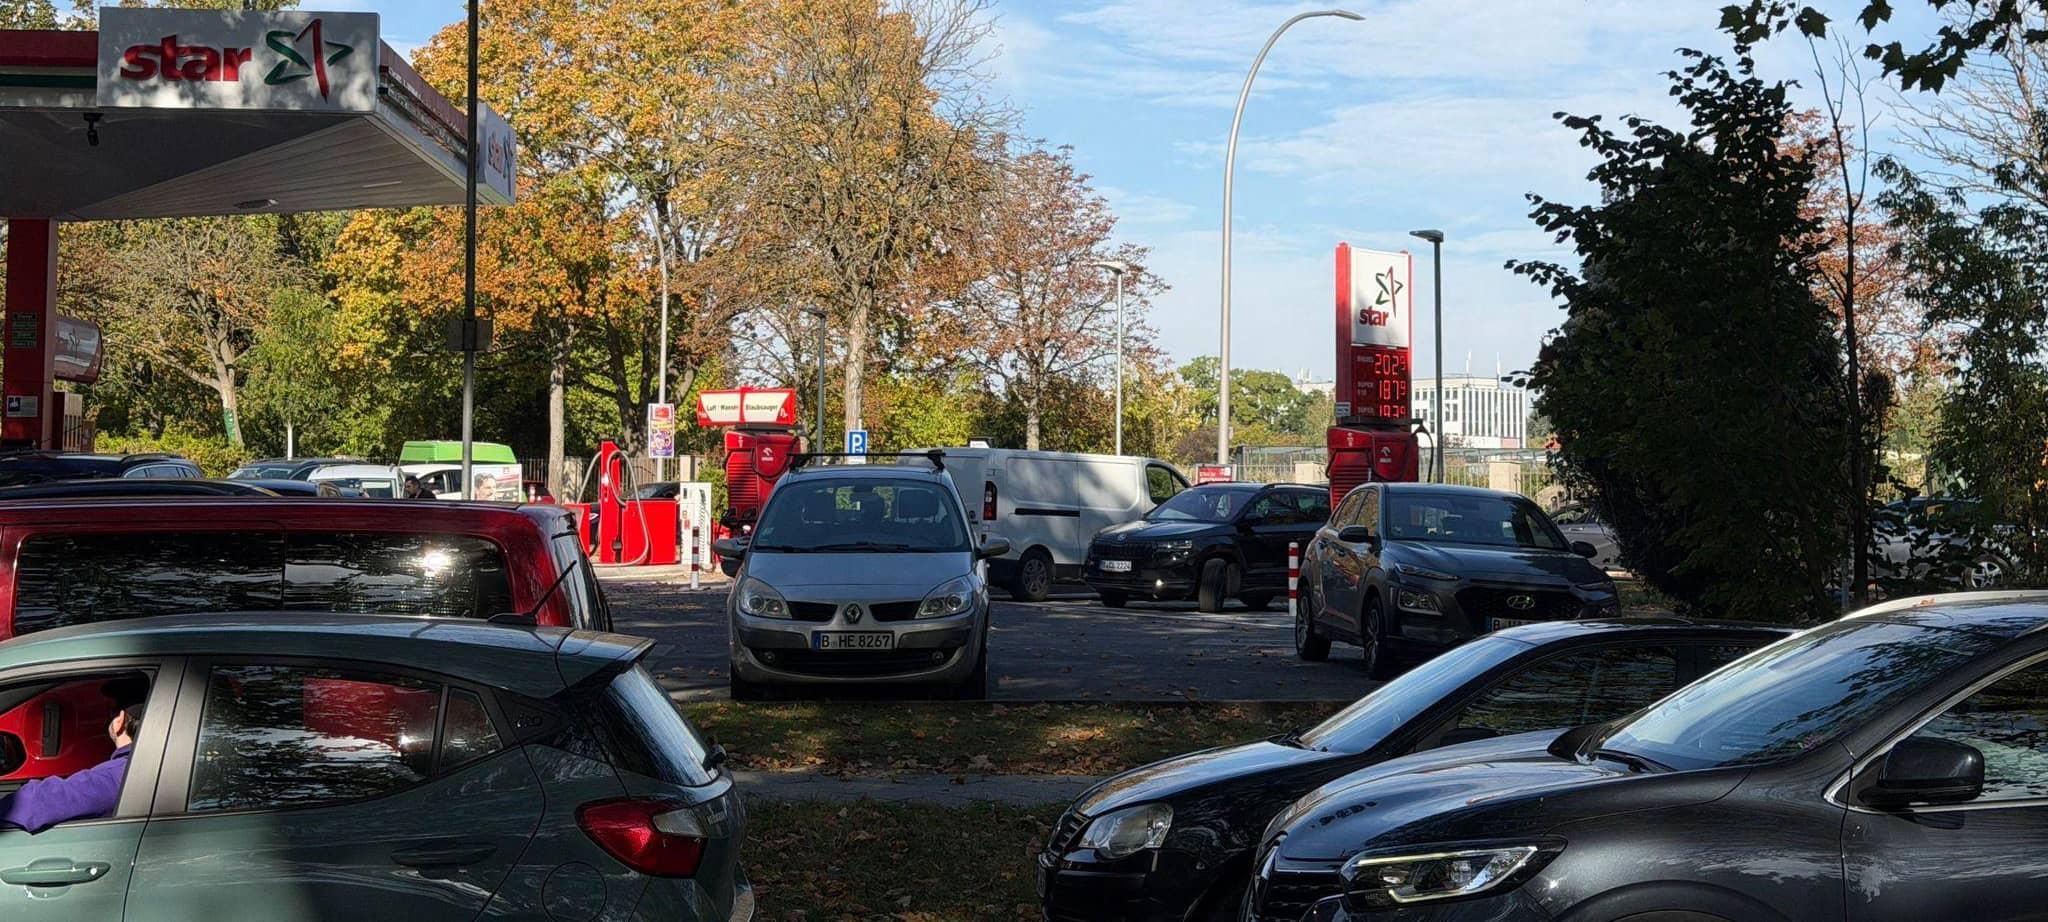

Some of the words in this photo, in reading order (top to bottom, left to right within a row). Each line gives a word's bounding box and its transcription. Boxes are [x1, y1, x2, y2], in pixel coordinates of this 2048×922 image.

[120, 34, 252, 82] star
[488, 131, 503, 174] star
[1359, 306, 1389, 327] star
[852, 433, 863, 455] P
[822, 635, 830, 648] B
[839, 635, 855, 648] HE
[859, 635, 890, 648] 8267
